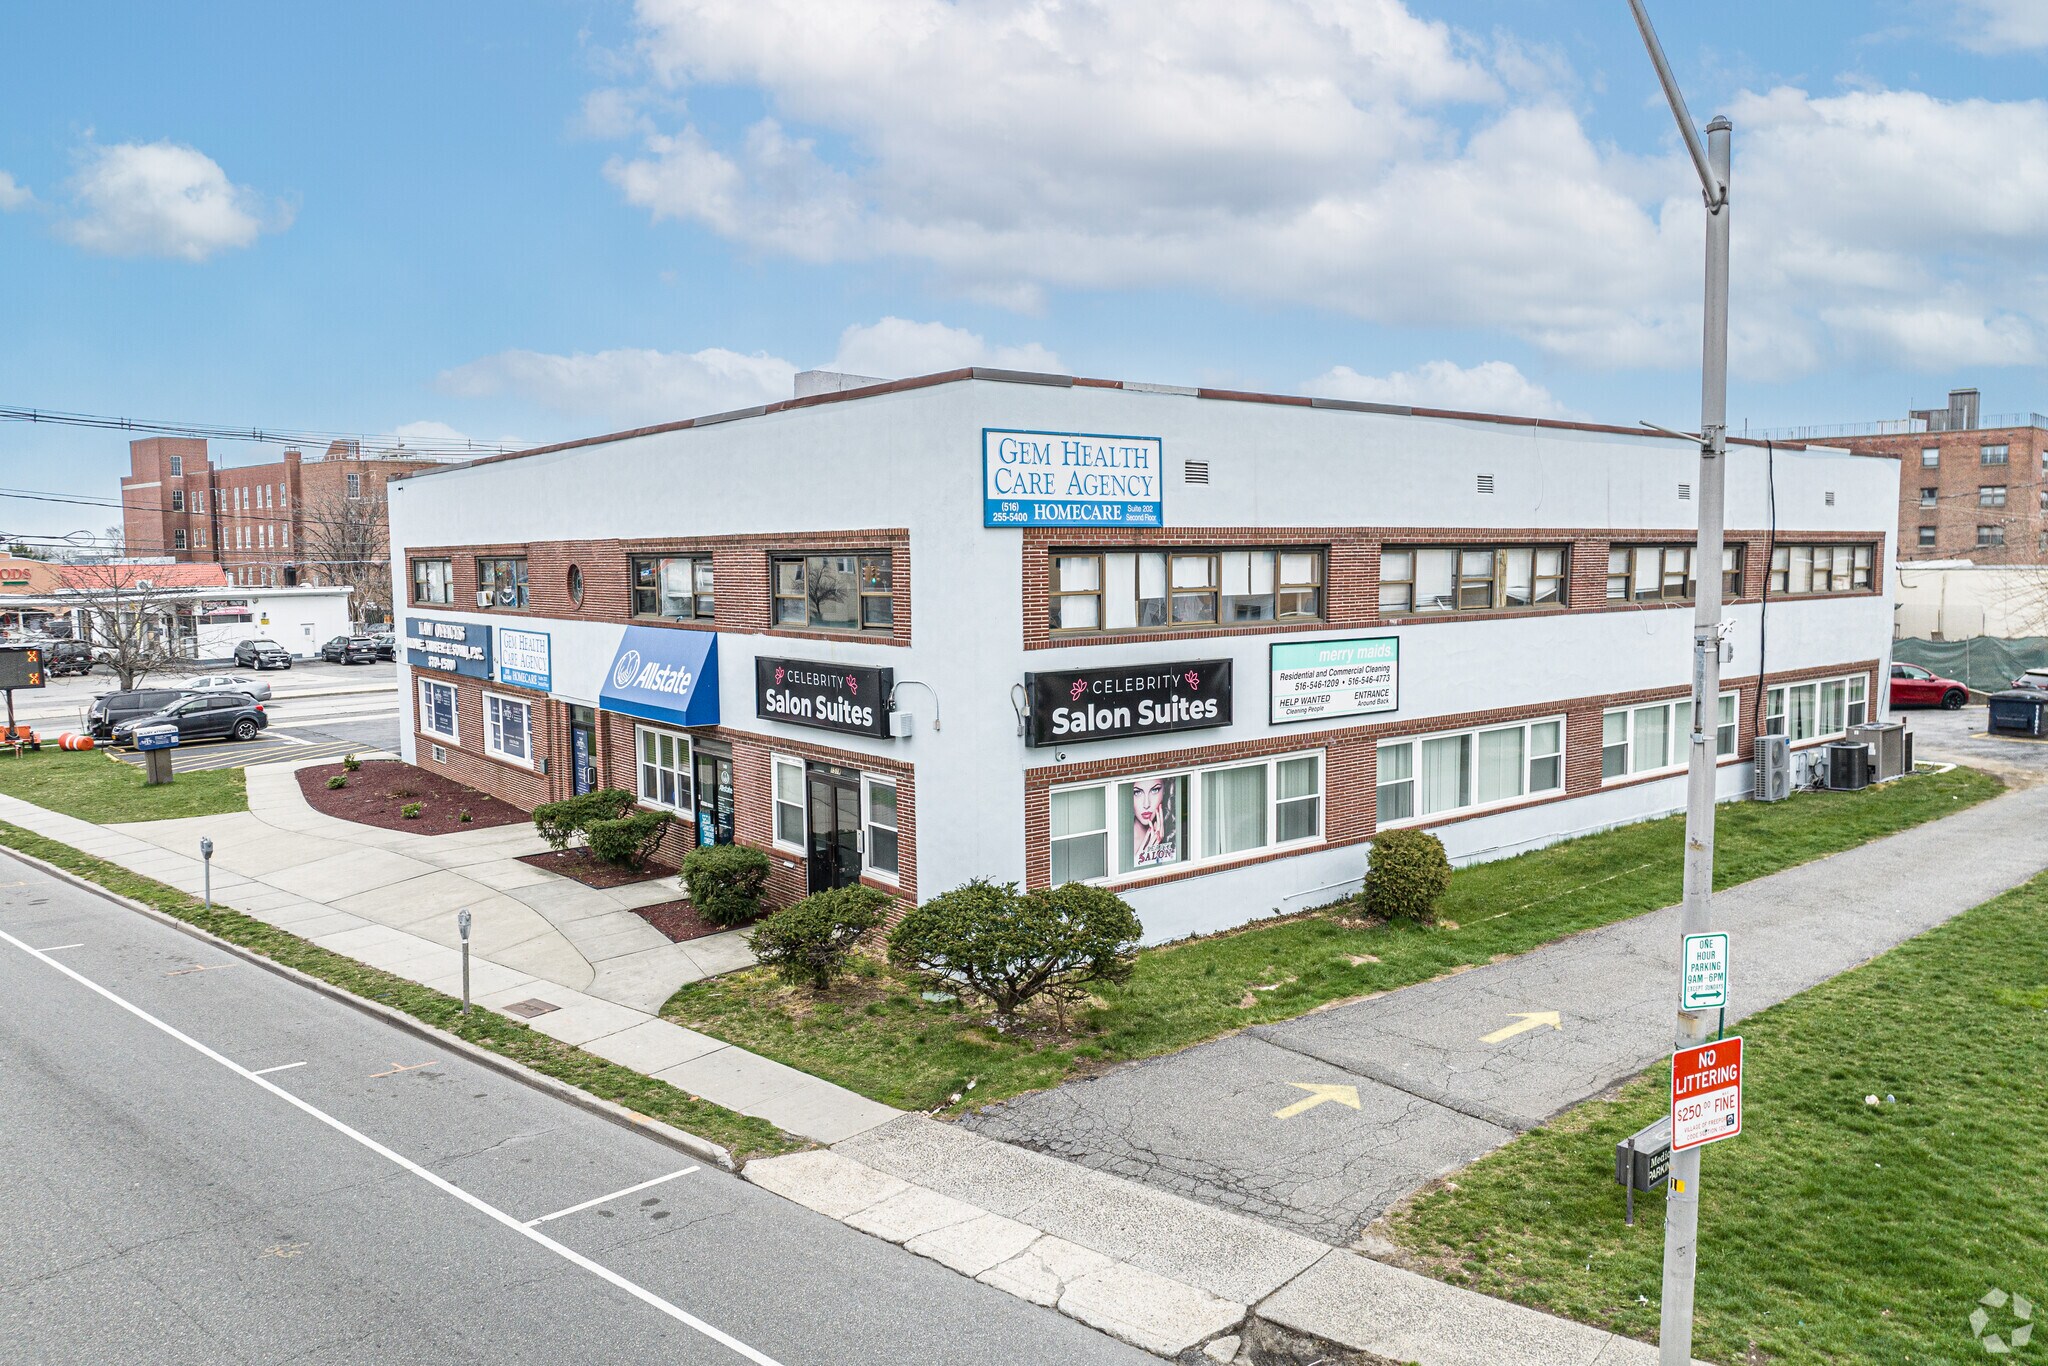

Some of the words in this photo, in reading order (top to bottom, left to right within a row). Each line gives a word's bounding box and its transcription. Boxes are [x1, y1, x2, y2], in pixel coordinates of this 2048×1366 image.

[999, 437, 1051, 466] GEM
[1061, 441, 1149, 469] HEALTH
[994, 467, 1056, 495] CARE
[1065, 470, 1153, 497] AGENCY
[1001, 501, 1019, 512] (516)
[1033, 503, 1122, 521] HOMECARE
[1127, 504, 1142, 513] Suite
[1142, 504, 1153, 513] 202
[992, 512, 1028, 522] 255-5400
[1125, 513, 1145, 522] Second
[1144, 513, 1156, 522] Floor
[504, 632, 517, 649] GEM
[519, 634, 546, 653] HEALTH
[503, 650, 518, 667] CARE
[520, 653, 547, 671] AGENCY
[1319, 648, 1354, 664] merry
[633, 661, 692, 695] Allstate
[787, 670, 844, 689] CELEBRITY
[1280, 671, 1315, 681] Residential
[1315, 669, 1328, 677] and
[1328, 666, 1364, 677] Commercial
[1365, 664, 1391, 674] Cleaning
[1092, 674, 1181, 695] CELEBRITY
[1294, 678, 1340, 691] 516-546-1209
[1347, 674, 1391, 686] 516-546-4773
[1279, 697, 1299, 707] HELP
[1300, 694, 1331, 705] WANTED
[1354, 688, 1390, 700] ENTRANCE
[1357, 699, 1377, 707] Around
[1376, 697, 1389, 705] Back
[766, 688, 812, 718] Salon
[815, 695, 873, 727] Suites
[1052, 703, 1131, 735] Salon
[1138, 695, 1218, 726] Suites
[1285, 707, 1308, 715] Cleaning
[1307, 705, 1325, 713] People
[1137, 849, 1171, 865] SALON
[1699, 939, 1713, 949] ONE
[1696, 950, 1716, 961] HOUR
[1691, 962, 1721, 972] PARKING
[1698, 1049, 1717, 1069] NO
[1676, 1064, 1738, 1094] LITTERING
[1714, 1094, 1736, 1113] FINE
[1684, 1123, 1702, 1134] VILLAGE
[1701, 1121, 1708, 1130] OF
[1708, 1115, 1727, 1126] FREEPOR
[1686, 1132, 1700, 1141] CODE
[1649, 1161, 1670, 1181] PARKIN
